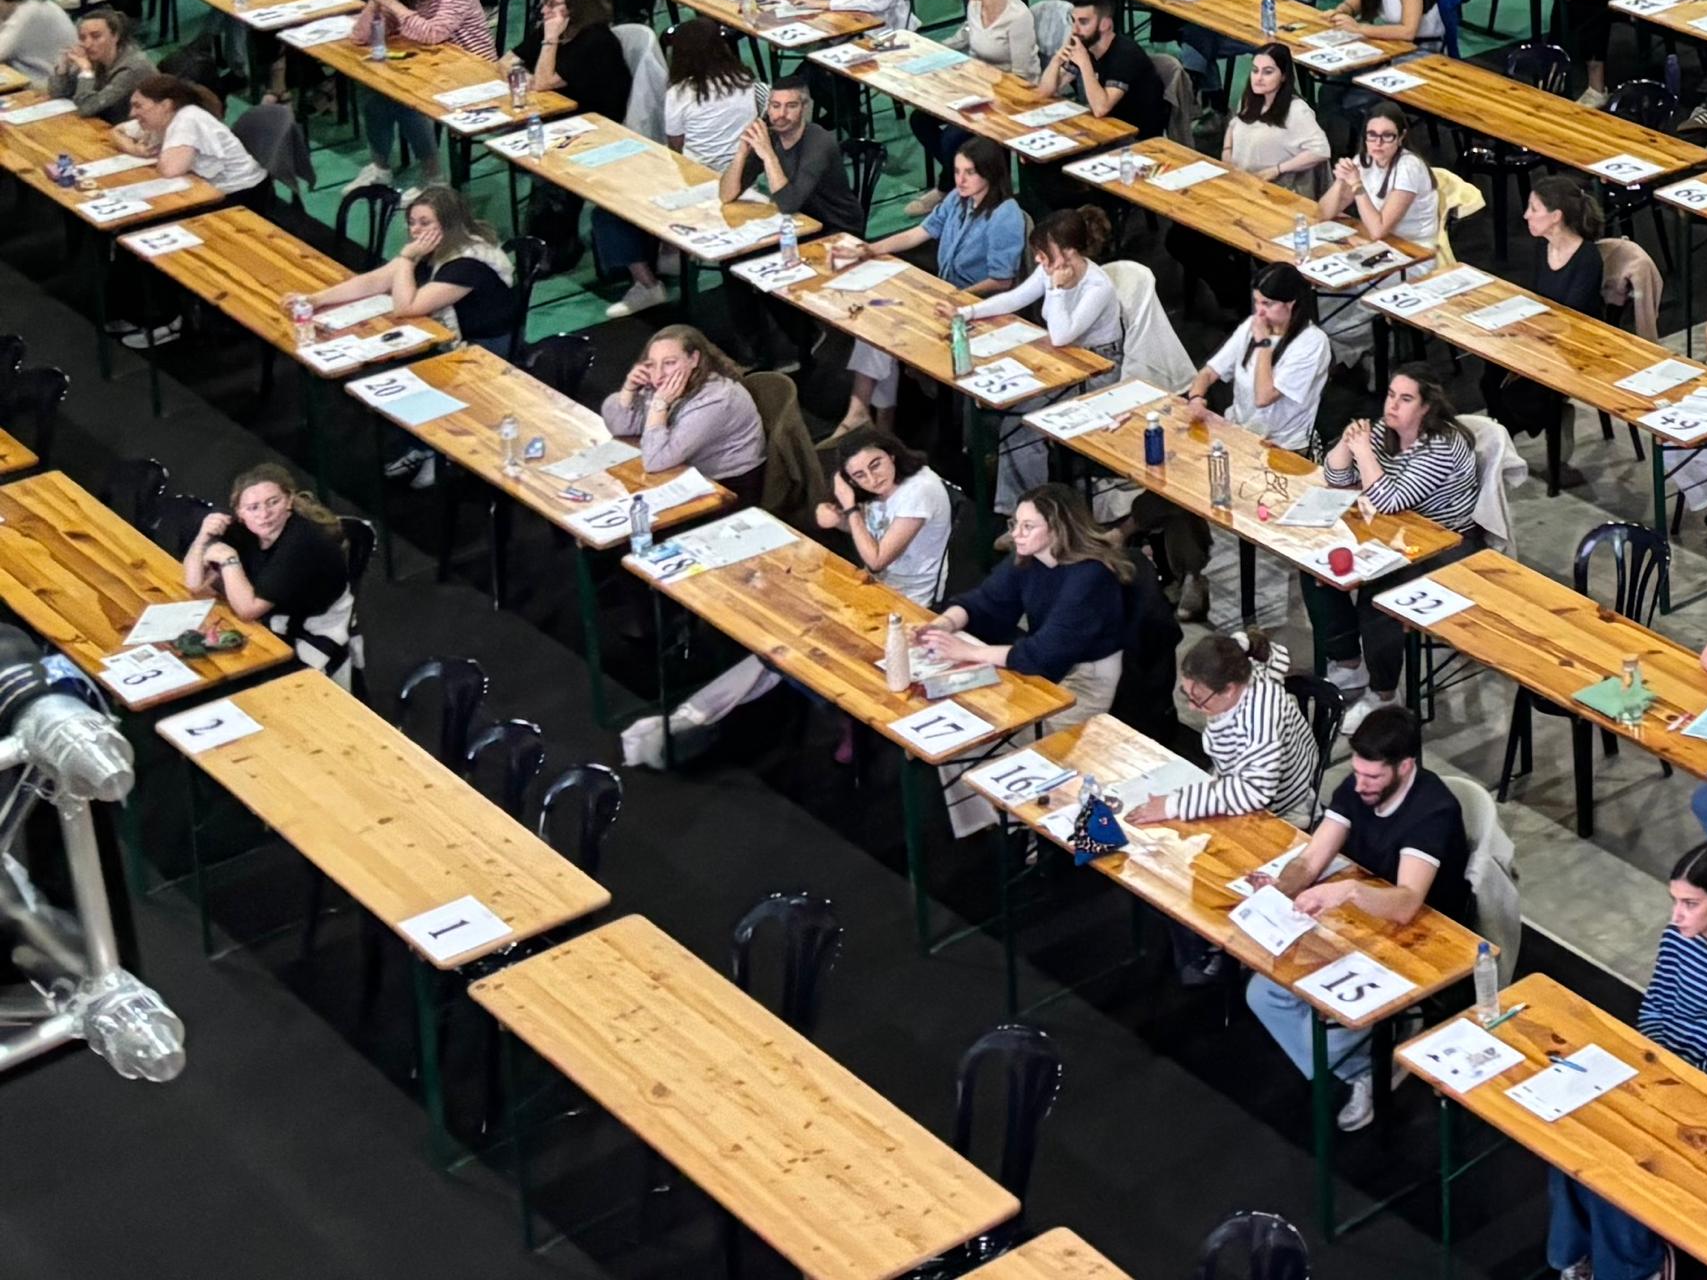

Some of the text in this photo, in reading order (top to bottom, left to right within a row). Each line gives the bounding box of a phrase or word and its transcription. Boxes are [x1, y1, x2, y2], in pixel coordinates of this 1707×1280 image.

[1605, 163, 1642, 175] 67
[1380, 293, 1422, 308] 50
[366, 379, 406, 396] 20
[583, 510, 629, 527] 19
[648, 552, 695, 573] 18
[1395, 592, 1444, 614] 32
[124, 669, 162, 685] 3
[185, 718, 224, 736] 2
[912, 716, 964, 739] 17
[990, 766, 1046, 791] 16
[428, 920, 469, 939] 1
[1322, 971, 1381, 1002] 15
